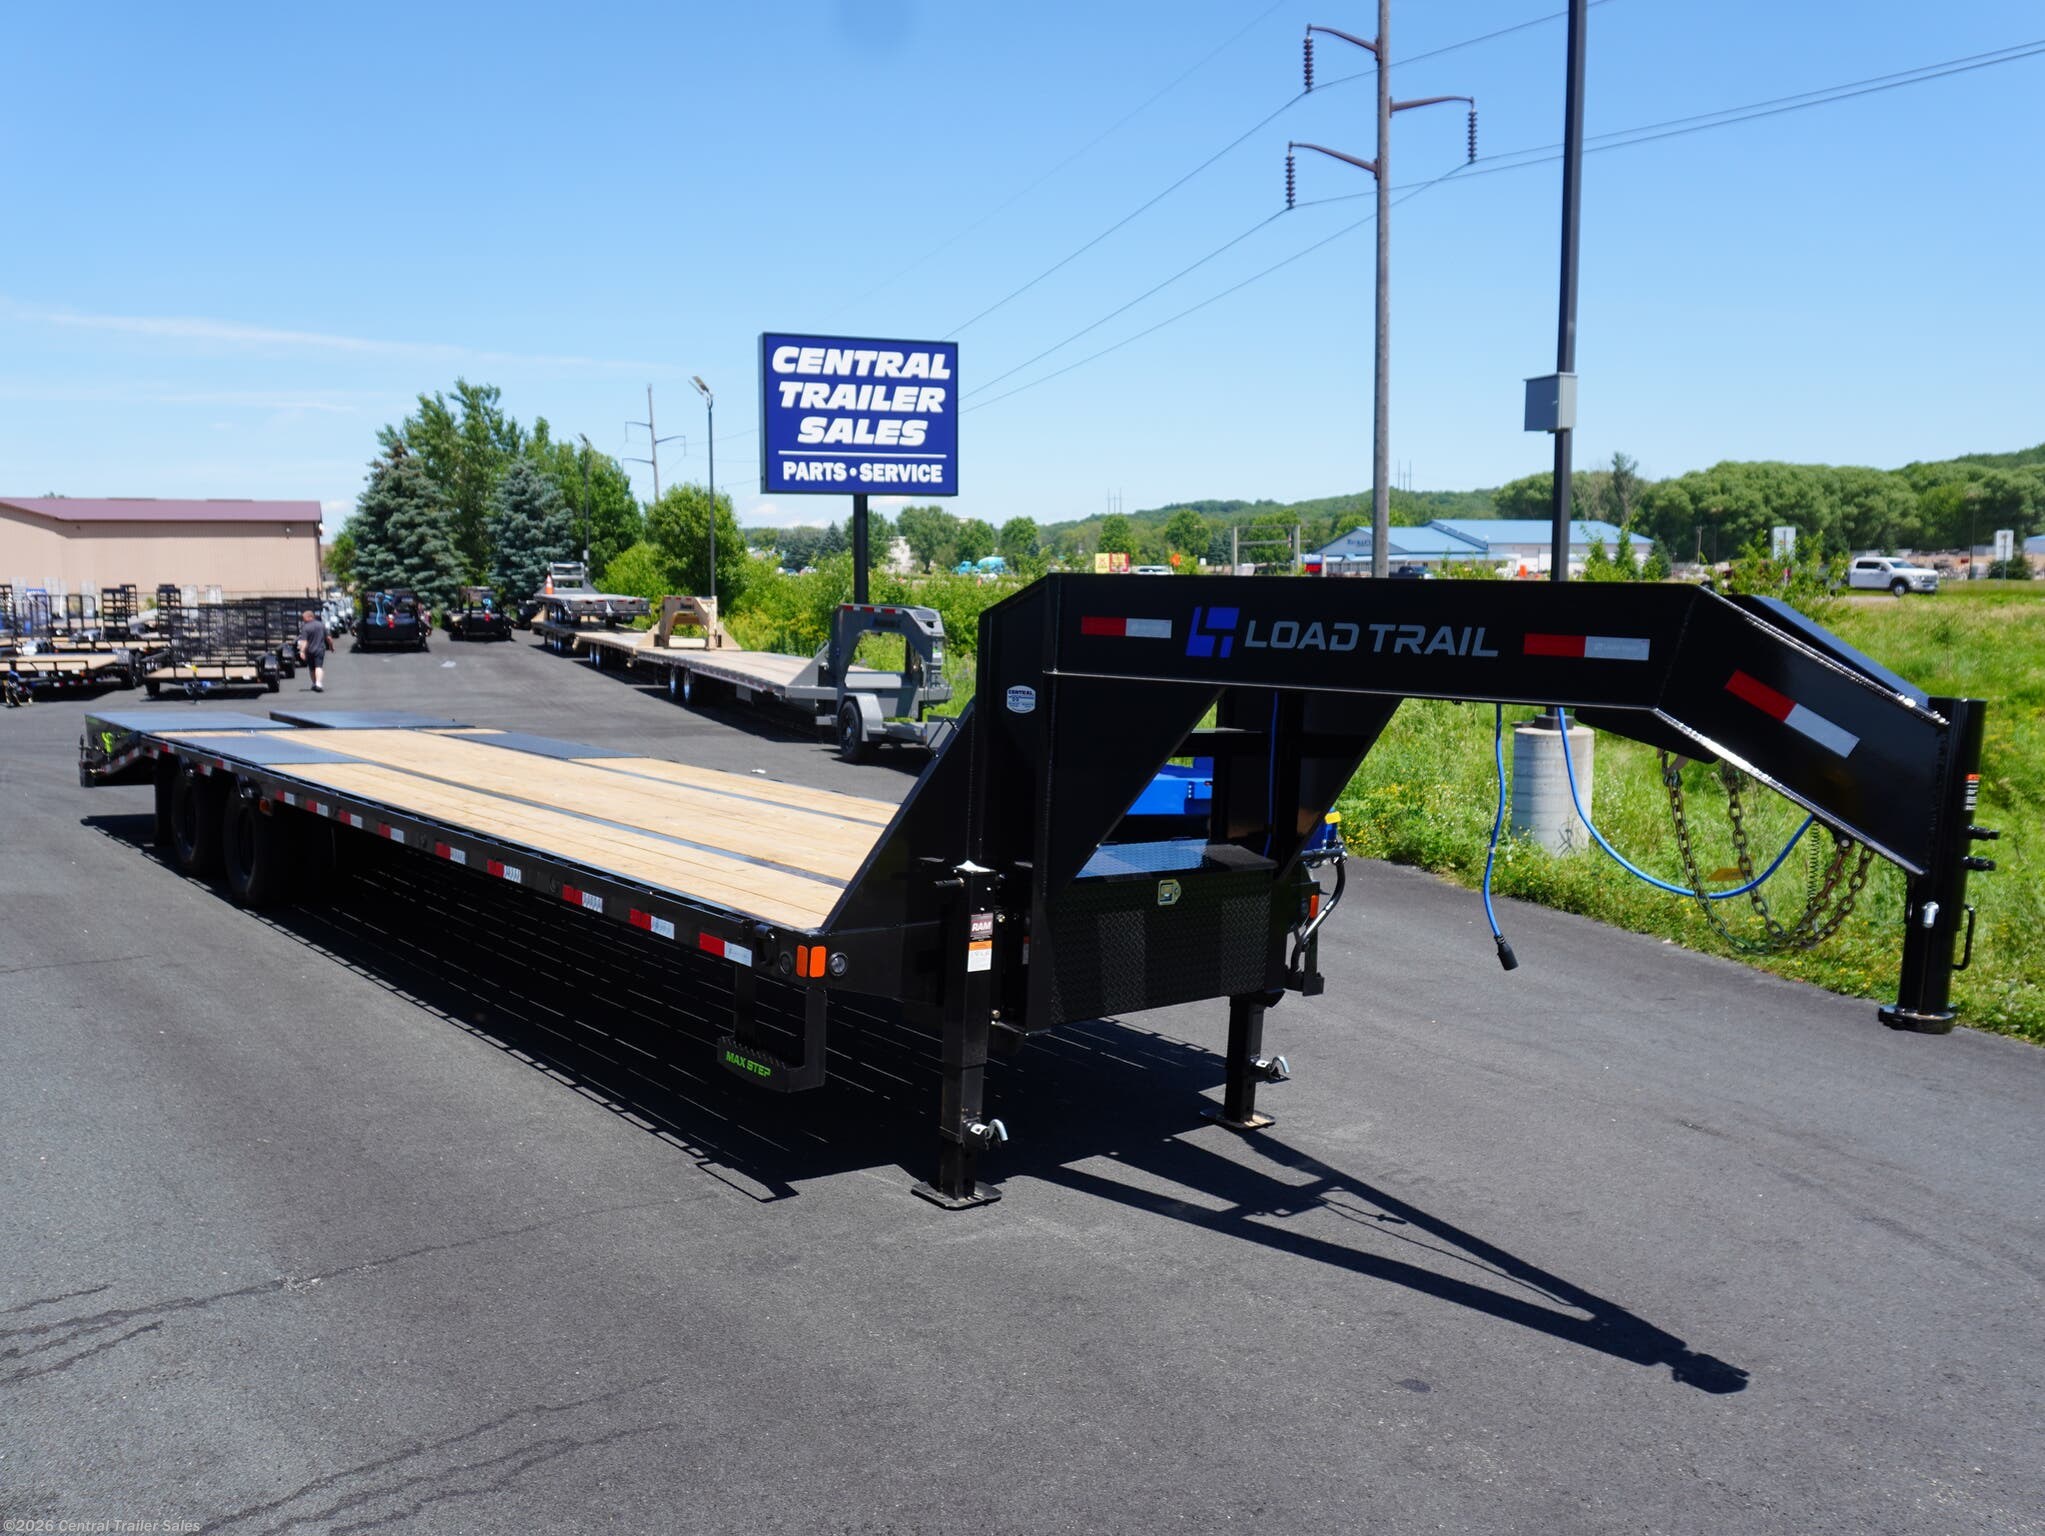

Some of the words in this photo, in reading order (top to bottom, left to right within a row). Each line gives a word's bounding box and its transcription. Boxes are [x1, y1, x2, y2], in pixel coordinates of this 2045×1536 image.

[772, 346, 951, 380] CENTRAL
[778, 381, 946, 413] TRAILER
[797, 416, 929, 447] SALES
[783, 461, 847, 481] PARTS
[859, 463, 943, 483] SERVICE
[1245, 620, 1360, 651] LOAD
[1368, 623, 1499, 657] TRAIL
[971, 921, 992, 932] RAM
[726, 1050, 746, 1068] MAX
[746, 1059, 772, 1077] STEP
